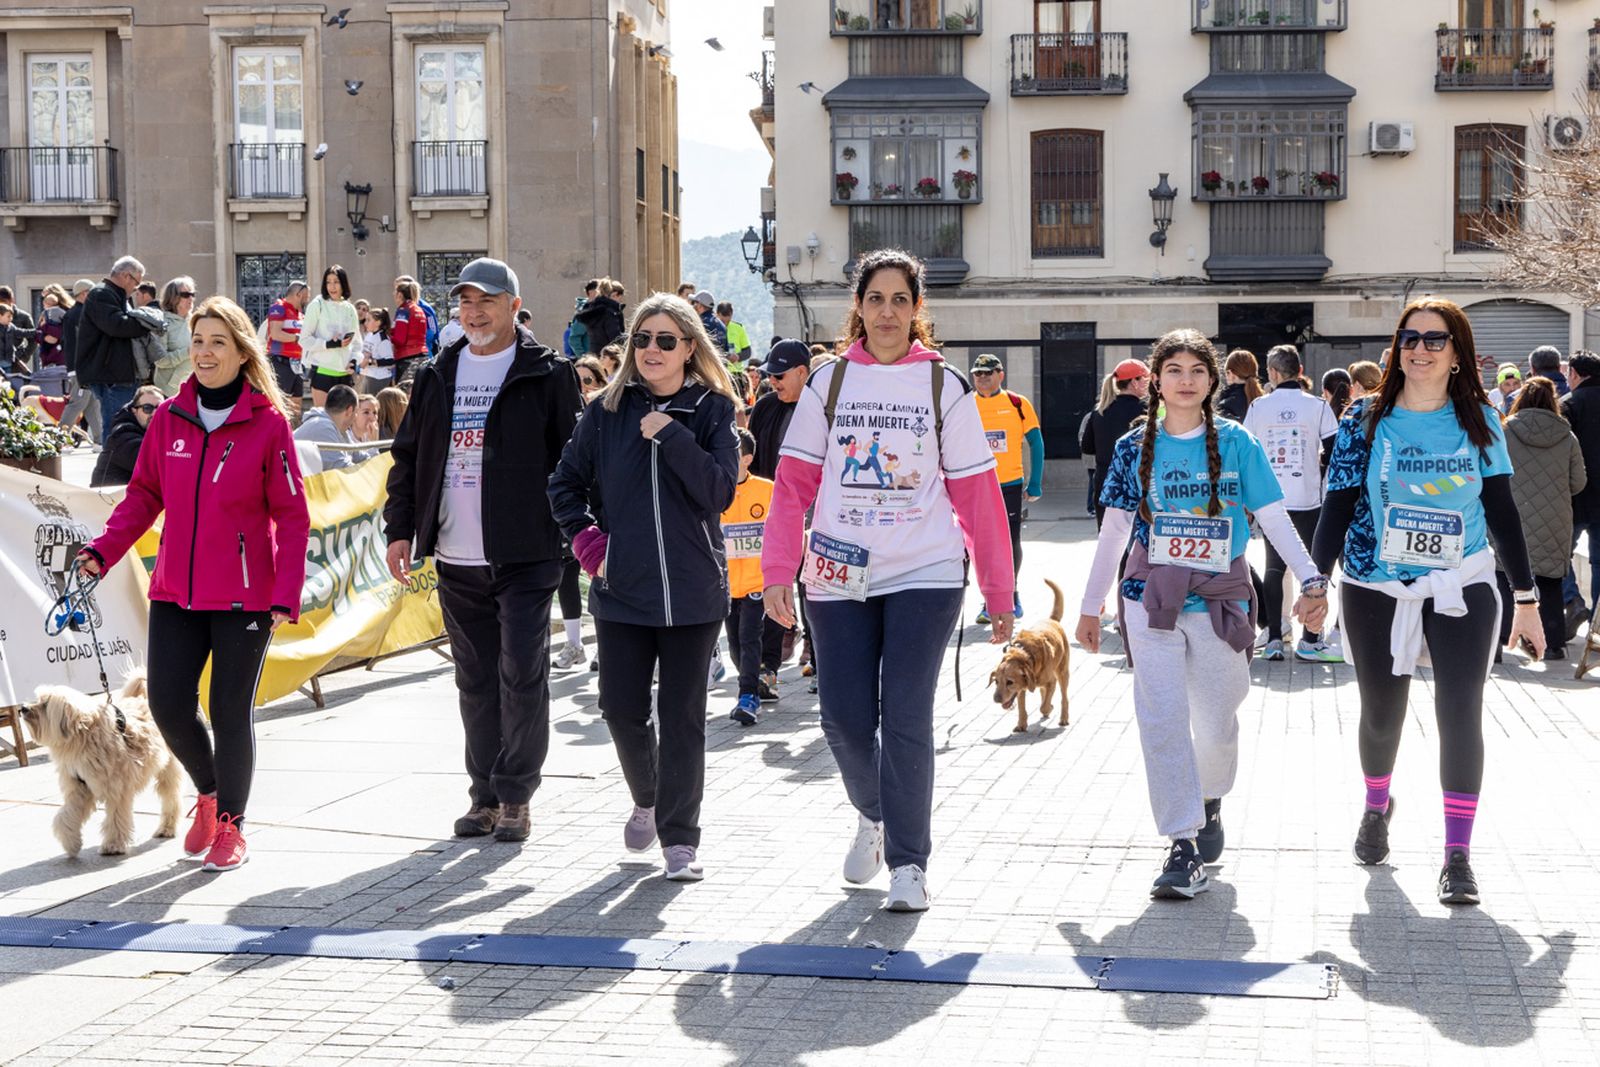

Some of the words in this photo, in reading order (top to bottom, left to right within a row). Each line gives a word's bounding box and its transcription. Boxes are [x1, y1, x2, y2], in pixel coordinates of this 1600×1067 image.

[845, 402, 883, 411] CARRERA
[886, 403, 930, 415] CAMINATA
[836, 414, 865, 428] BUENA
[868, 416, 910, 429] MUERTE
[452, 430, 485, 448] 985
[1396, 458, 1475, 473] MAPACHE
[1161, 525, 1182, 535] BUENA
[1183, 526, 1209, 537] MUERTE
[1395, 518, 1417, 529] BUENA
[1418, 520, 1445, 532] MUERTE
[733, 537, 762, 551] 1156
[1168, 537, 1211, 560] 822
[1405, 531, 1443, 555] 188
[816, 556, 849, 584] 954
[46, 643, 93, 663] CIUDAD
[109, 636, 132, 656] JAÉN
